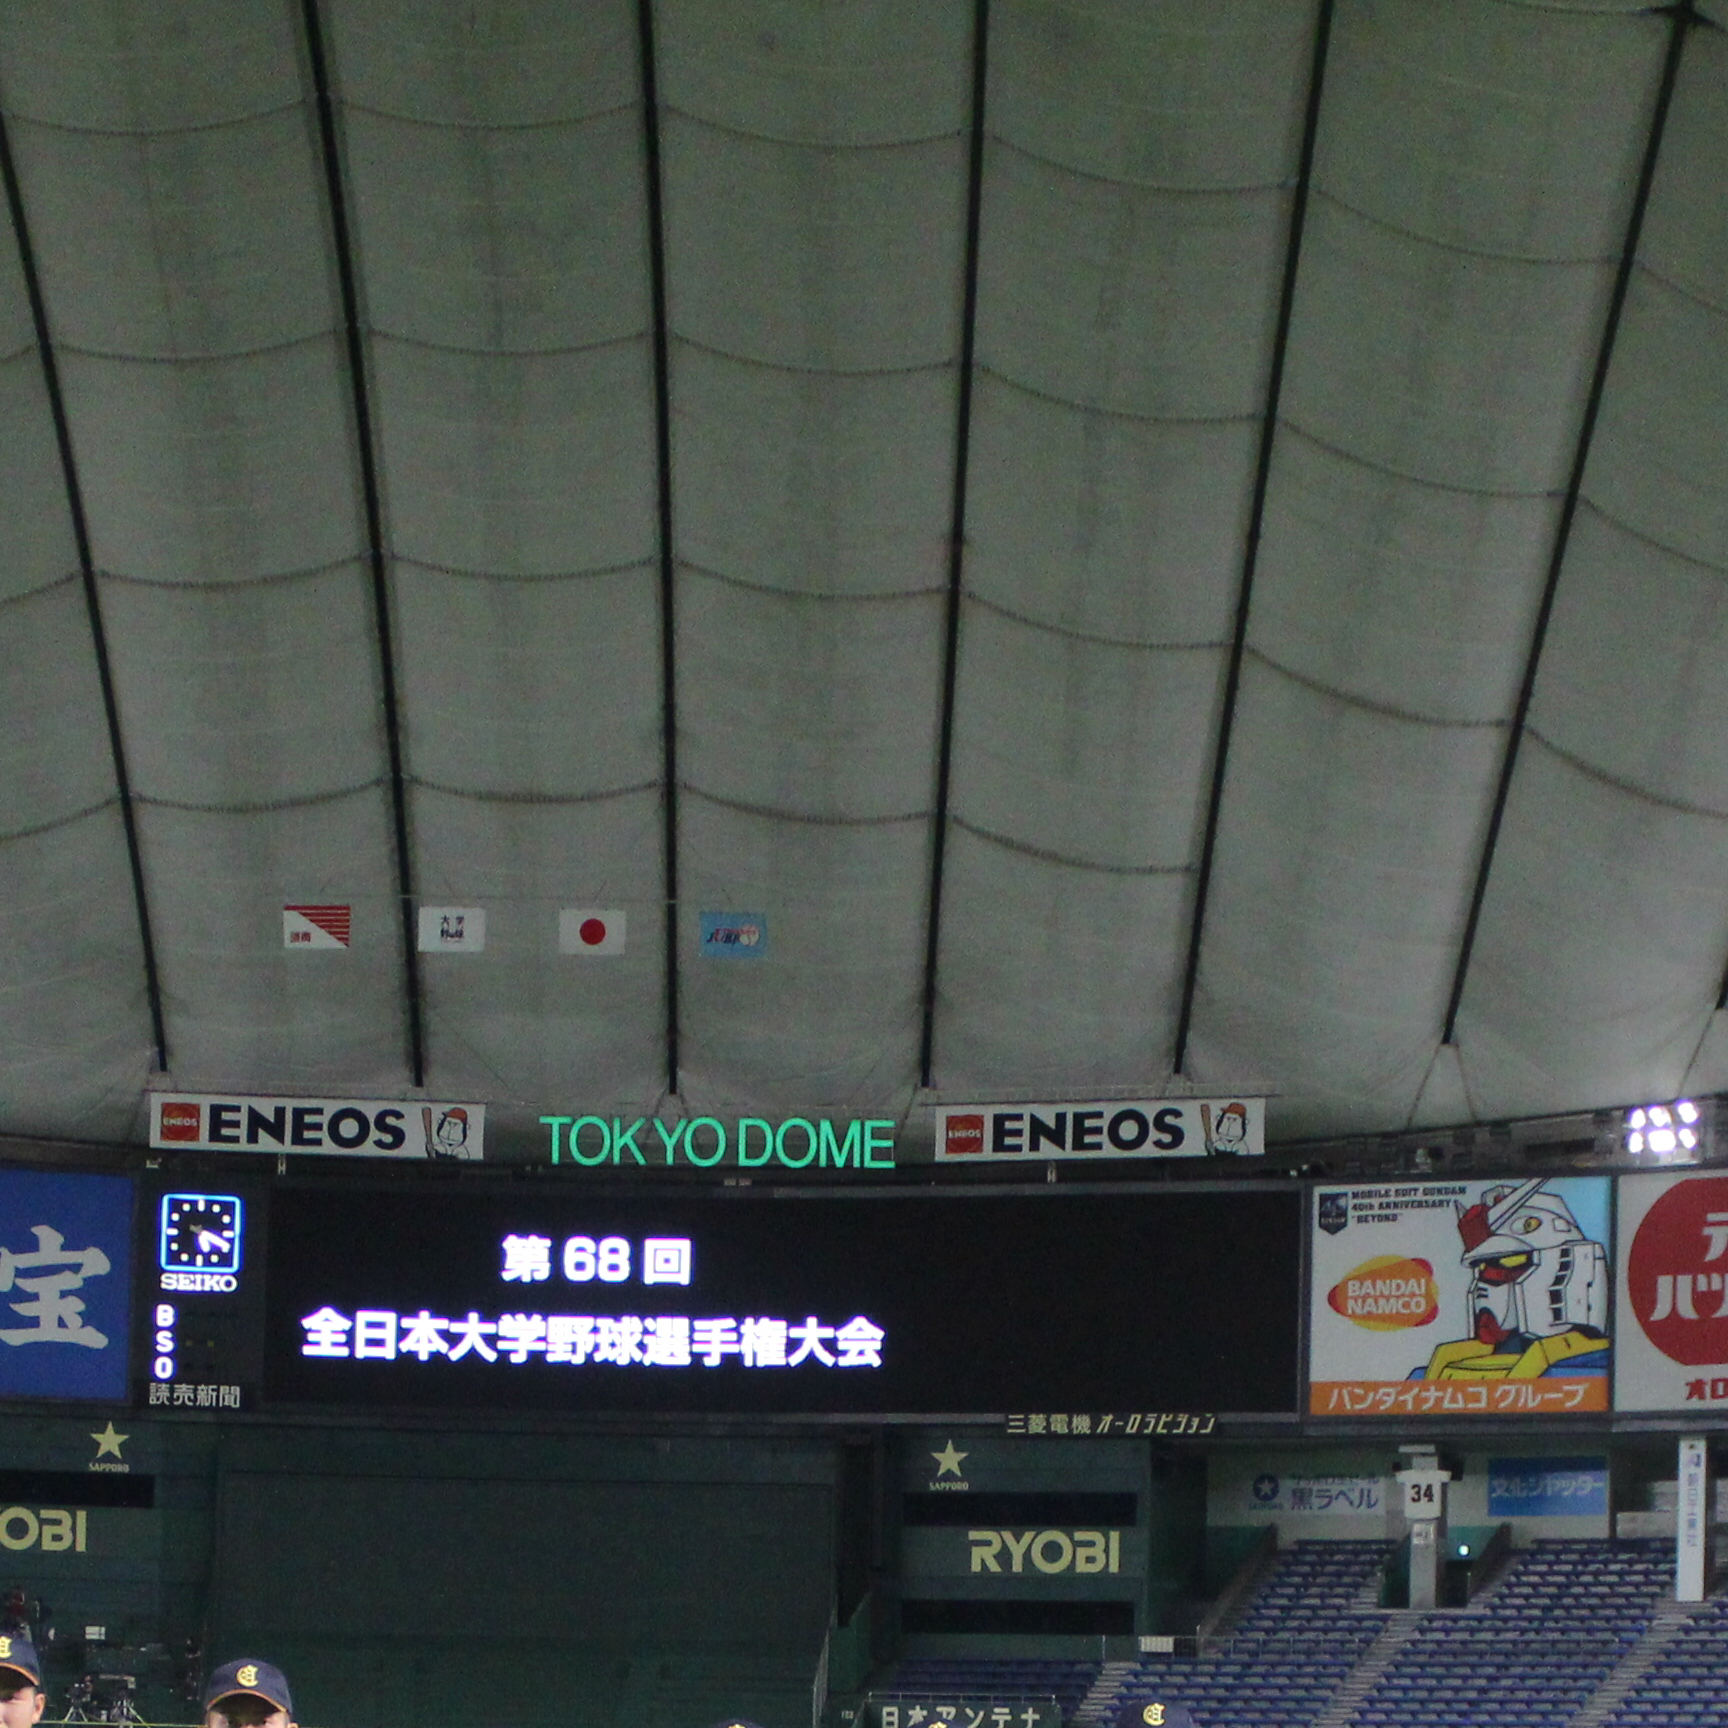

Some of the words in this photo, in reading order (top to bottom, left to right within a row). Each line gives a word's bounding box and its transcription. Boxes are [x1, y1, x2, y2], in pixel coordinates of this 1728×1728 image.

[162, 1117, 198, 1127] ENEOS
[208, 1103, 407, 1151] ENEOS
[991, 1107, 1186, 1154] ENEOS
[540, 1114, 727, 1168] TOKYO
[738, 1117, 896, 1169] DOME
[948, 1128, 983, 1140] ENEOS
[159, 1273, 238, 1293] SEIKO
[1348, 1279, 1426, 1297] BANDAI
[154, 1305, 175, 1328] B
[1347, 1297, 1427, 1315] NAMCO
[155, 1331, 174, 1354] S
[301, 1307, 886, 1368] 全日本大学野球選手権大会
[148, 1383, 241, 1408] 読売新聞
[1328, 1387, 1489, 1411] バンダイナムコ
[1494, 1383, 1590, 1408] グループ
[1007, 1413, 1091, 1435] 三菱電機
[88, 1461, 130, 1473] SAPPORO
[928, 1481, 969, 1492] SAPPORO
[1410, 1484, 1434, 1503] 34
[968, 1530, 1120, 1574] RYOBI
